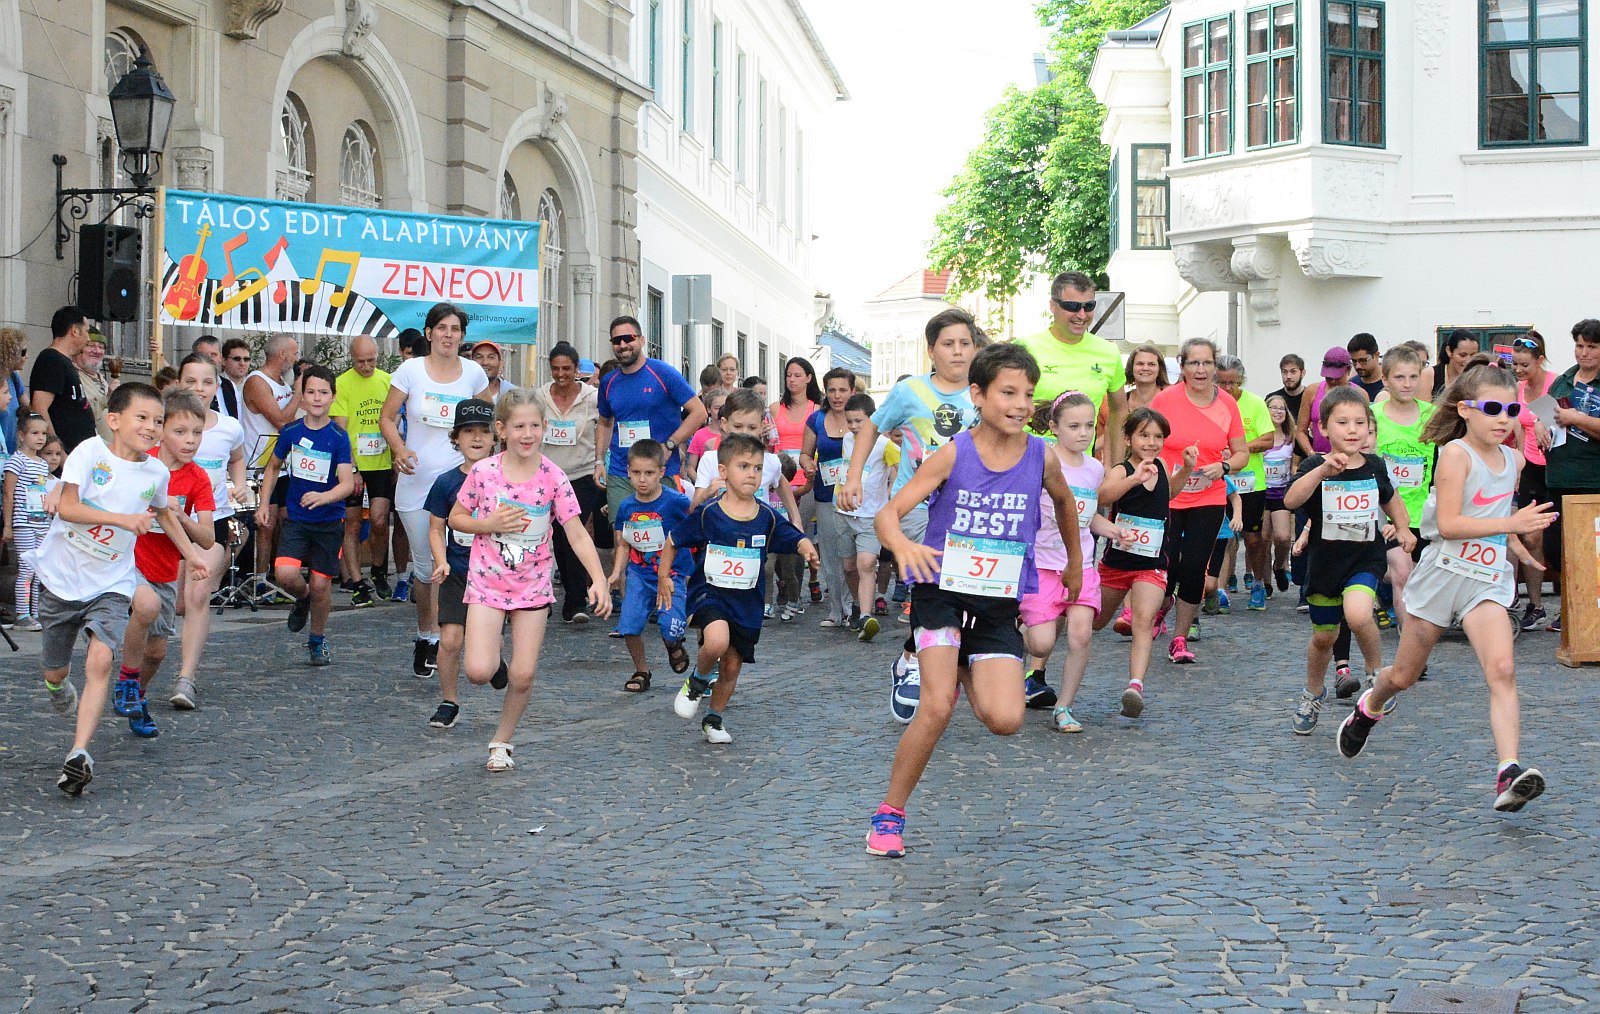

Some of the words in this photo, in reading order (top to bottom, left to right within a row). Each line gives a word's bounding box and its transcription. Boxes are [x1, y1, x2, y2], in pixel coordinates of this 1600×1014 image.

[176, 198, 270, 232] TÁLOS
[285, 210, 347, 238] EDIT
[361, 217, 529, 252] ALAPÍTVÁNY
[381, 263, 524, 302] ZENEOVI
[356, 408, 380, 416] FUTOTT
[440, 405, 449, 417] 8
[551, 428, 567, 438] 126
[628, 429, 636, 439] 5
[367, 440, 380, 449] 48
[300, 457, 316, 471] 86
[1265, 467, 1279, 475] 112
[1392, 466, 1410, 478] 46
[956, 489, 982, 508] BE
[991, 492, 1028, 510] THE
[1336, 493, 1370, 511] 105
[520, 517, 532, 533] 7
[951, 507, 1025, 536] BEST
[86, 524, 115, 546] 42
[633, 530, 651, 543] 84
[1131, 528, 1150, 545] 36
[1460, 541, 1497, 566] 120
[721, 559, 745, 577] 26
[968, 555, 999, 578] 37
